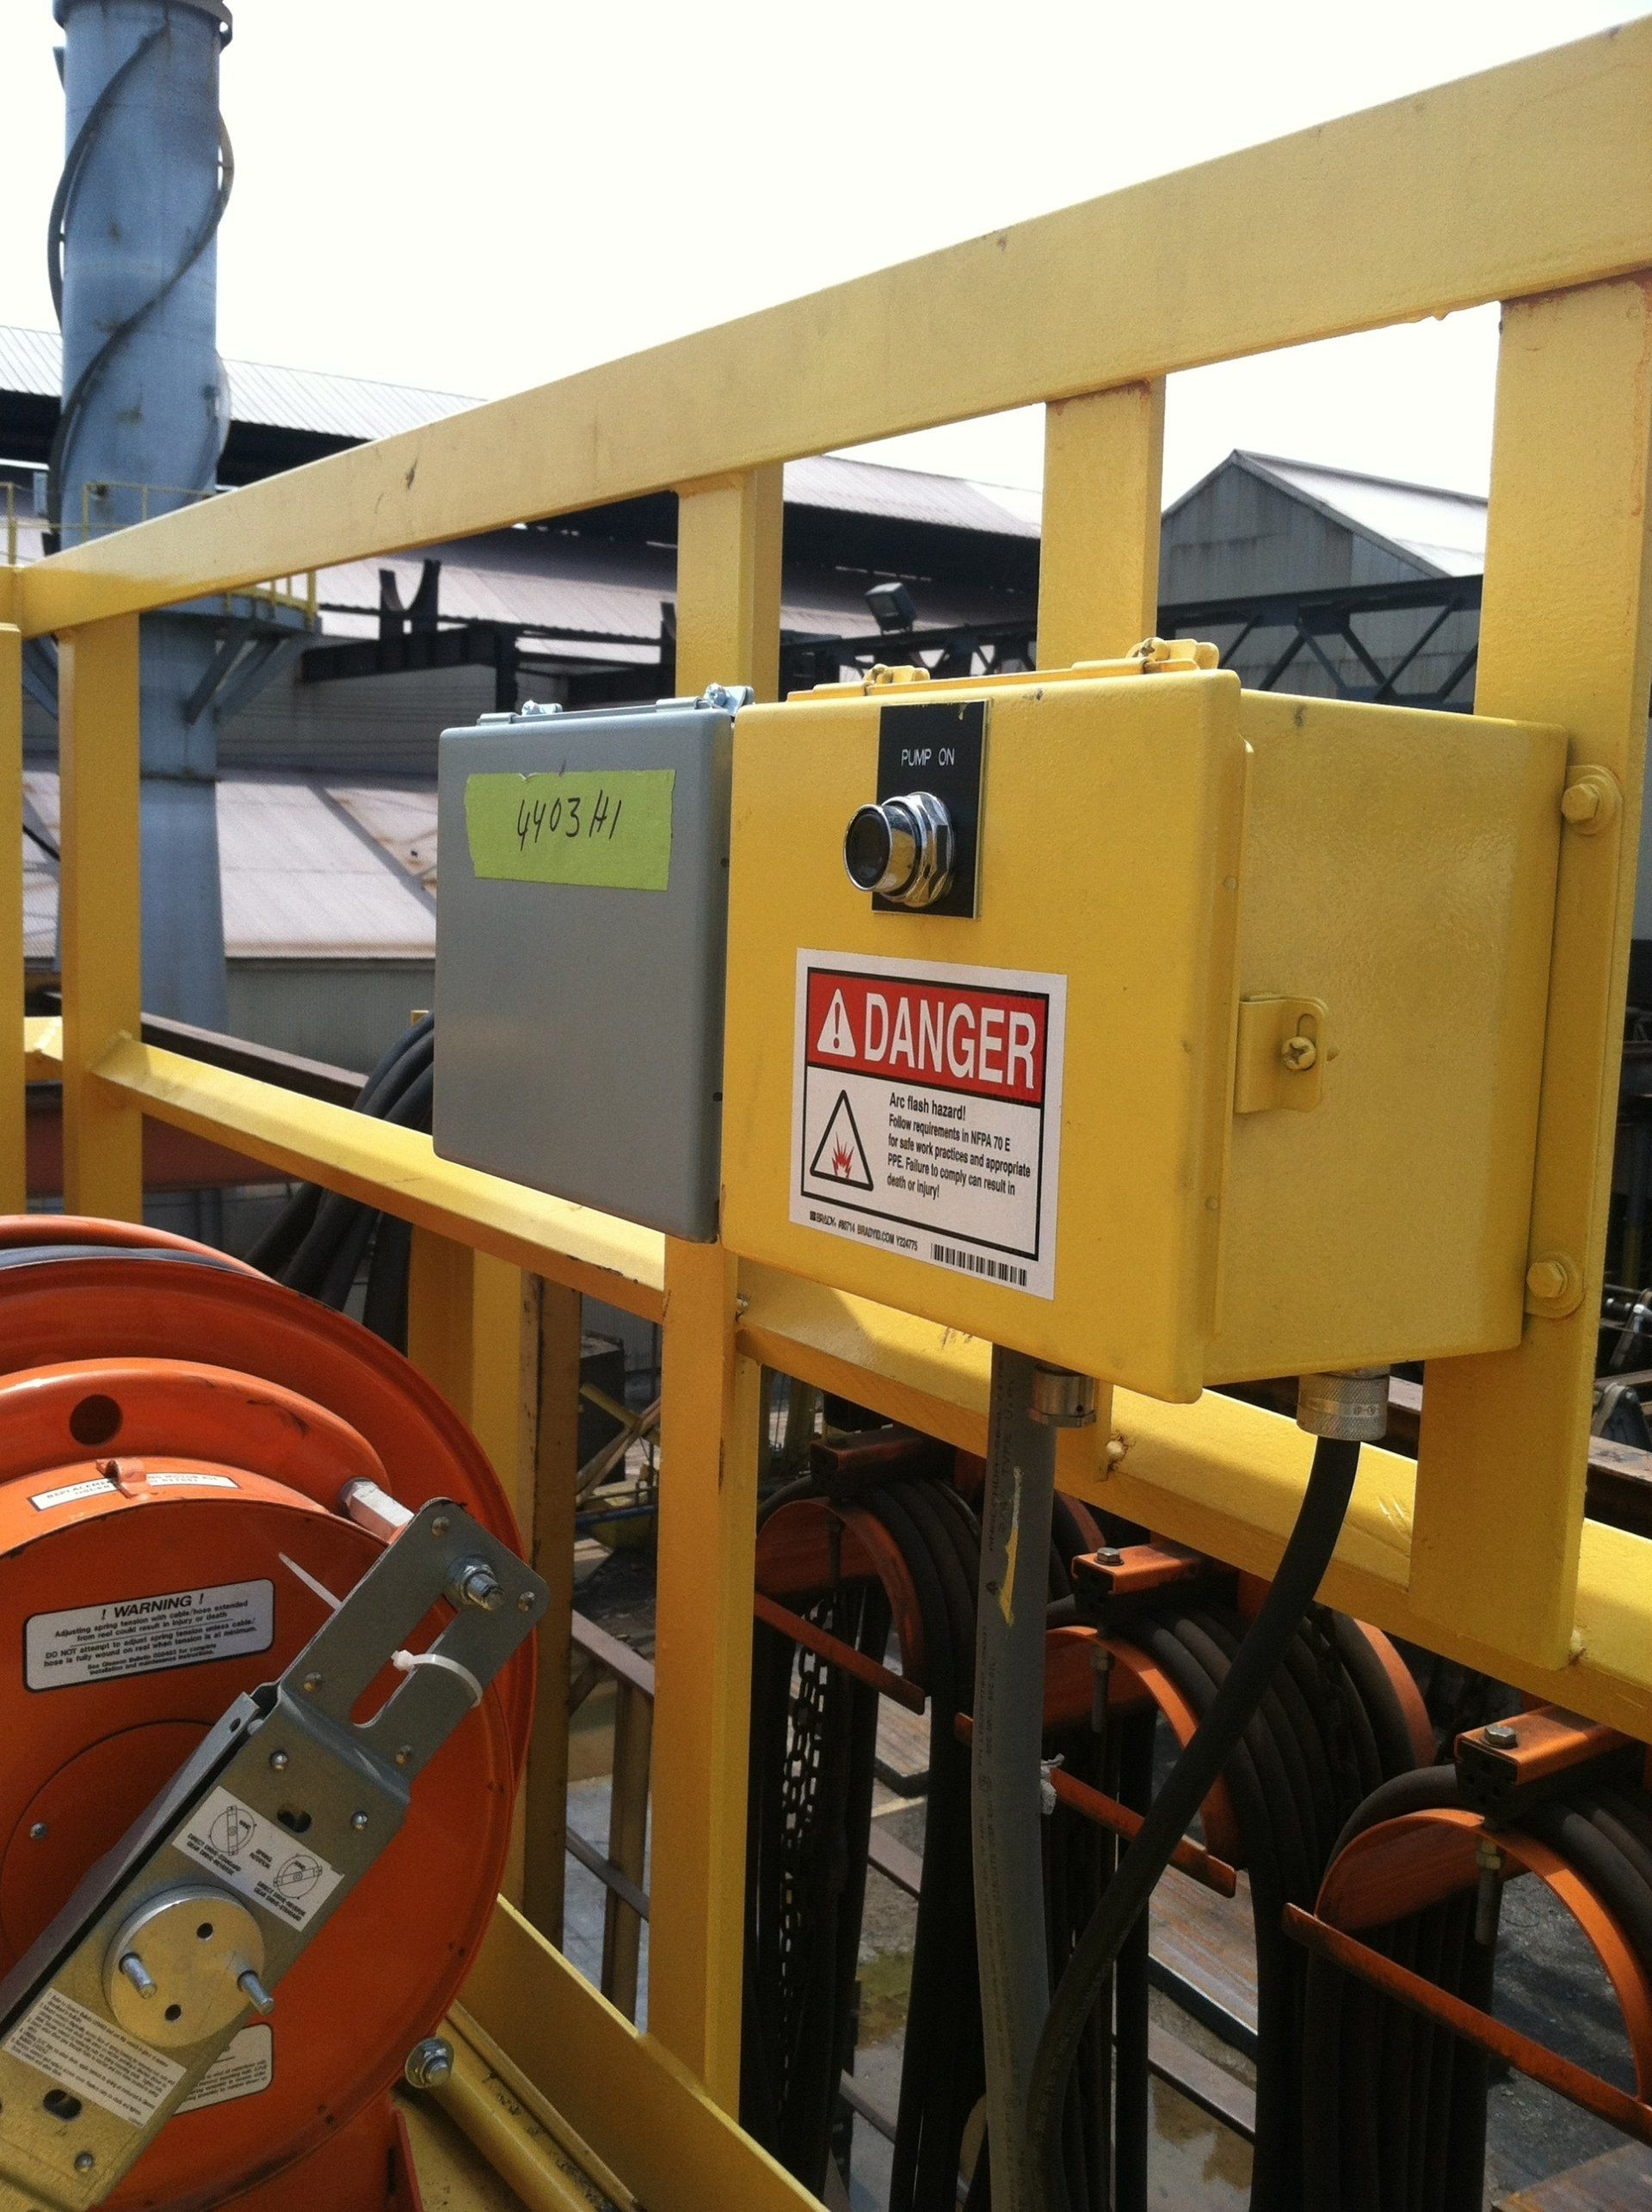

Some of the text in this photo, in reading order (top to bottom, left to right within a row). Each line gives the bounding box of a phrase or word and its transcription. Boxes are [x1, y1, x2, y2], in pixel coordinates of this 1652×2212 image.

[901, 748, 955, 767] PUMP ON
[864, 992, 1036, 1089] DANGER
[889, 1092, 966, 1121] Arc flash hazard!
[889, 1113, 1010, 1152] Follow requirements in NFPA 70 E
[888, 1132, 1031, 1178] for safe work practices and appropriate
[887, 1153, 1015, 1195] PPE. Failure to comply can result in
[887, 1173, 940, 1200] death or injury!
[857, 1223, 894, 1244] BRADYID.COM
[54, 1626, 91, 1637] Adjusting
[94, 1622, 118, 1631] spring
[120, 1617, 149, 1626] tension
[169, 1607, 212, 1618] cable/hose
[214, 1600, 248, 1611] extended
[114, 1595, 192, 1617] WARNING
[97, 1630, 113, 1639] reel
[115, 1627, 137, 1636] could
[139, 1622, 160, 1631] result
[172, 1617, 193, 1626] injury
[206, 1611, 227, 1621] death
[44, 1659, 63, 1667] hose
[76, 1654, 92, 1662] fully
[95, 1648, 120, 1658] wound
[175, 1636, 202, 1645] tension
[60, 1648, 77, 1656] NOT
[79, 1643, 110, 1653] attempt
[124, 1636, 147, 1647] adjust
[151, 1633, 173, 1642] spring
[176, 1628, 203, 1637] tension
